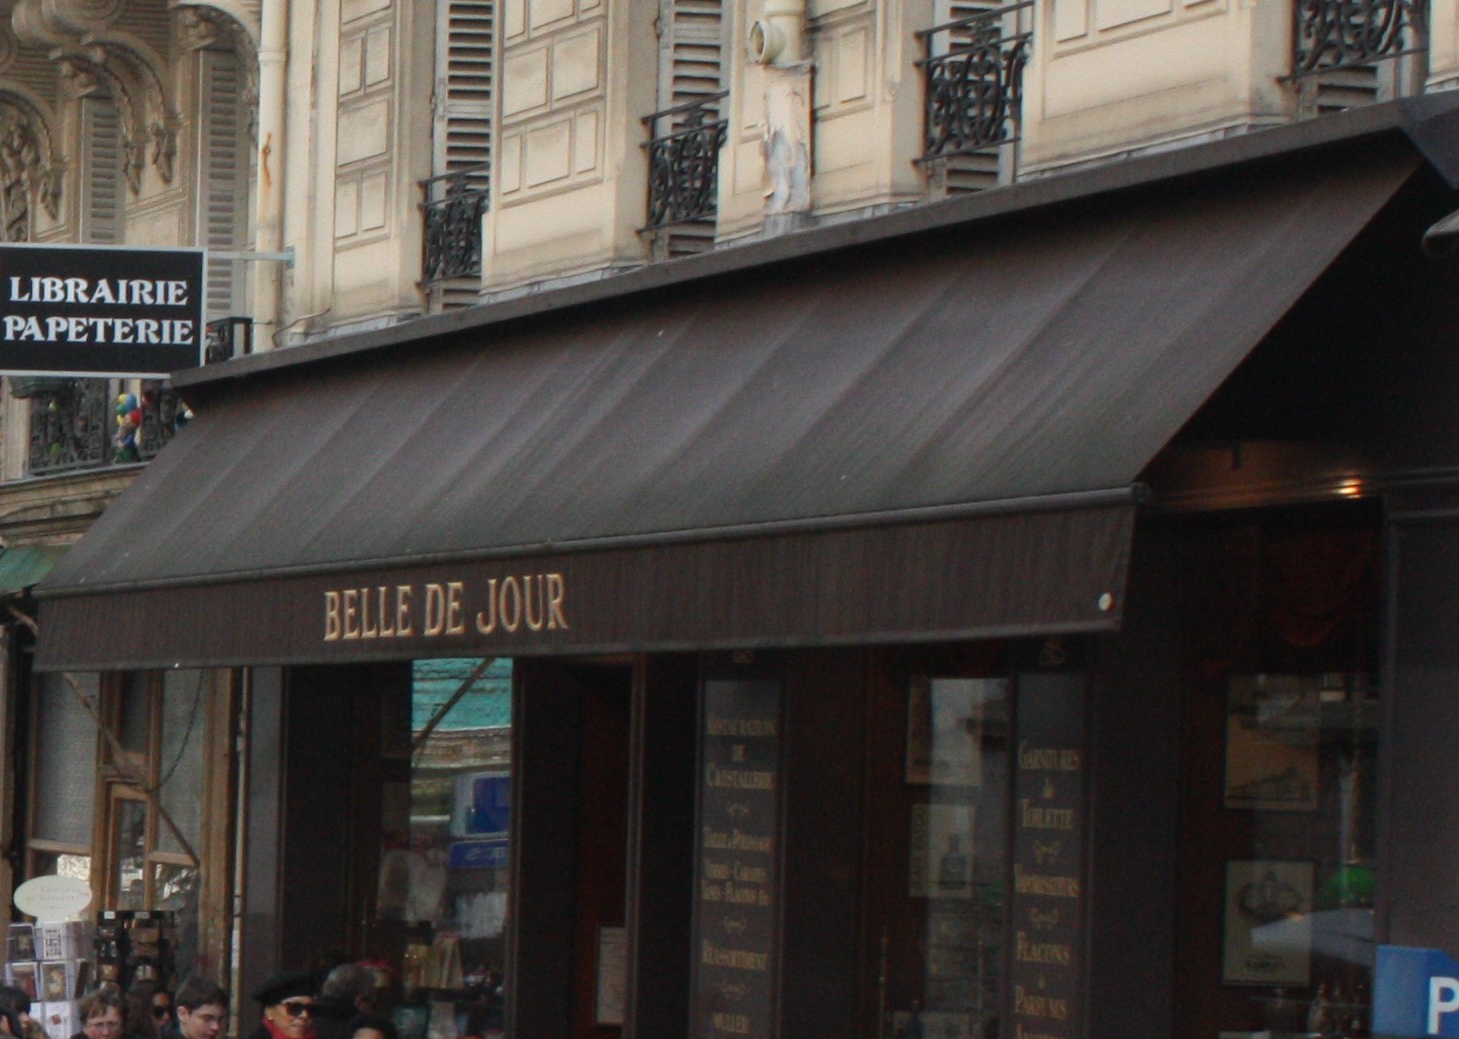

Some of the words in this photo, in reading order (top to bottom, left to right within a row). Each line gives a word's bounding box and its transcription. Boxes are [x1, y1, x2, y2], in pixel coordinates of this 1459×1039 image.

[9, 276, 189, 306] LIBRAIRIE
[2, 314, 194, 345] PAPETERIE
[323, 584, 415, 642] BELLE
[423, 581, 466, 637] DE
[476, 573, 571, 635] JOUR
[1427, 976, 1459, 1035] P
